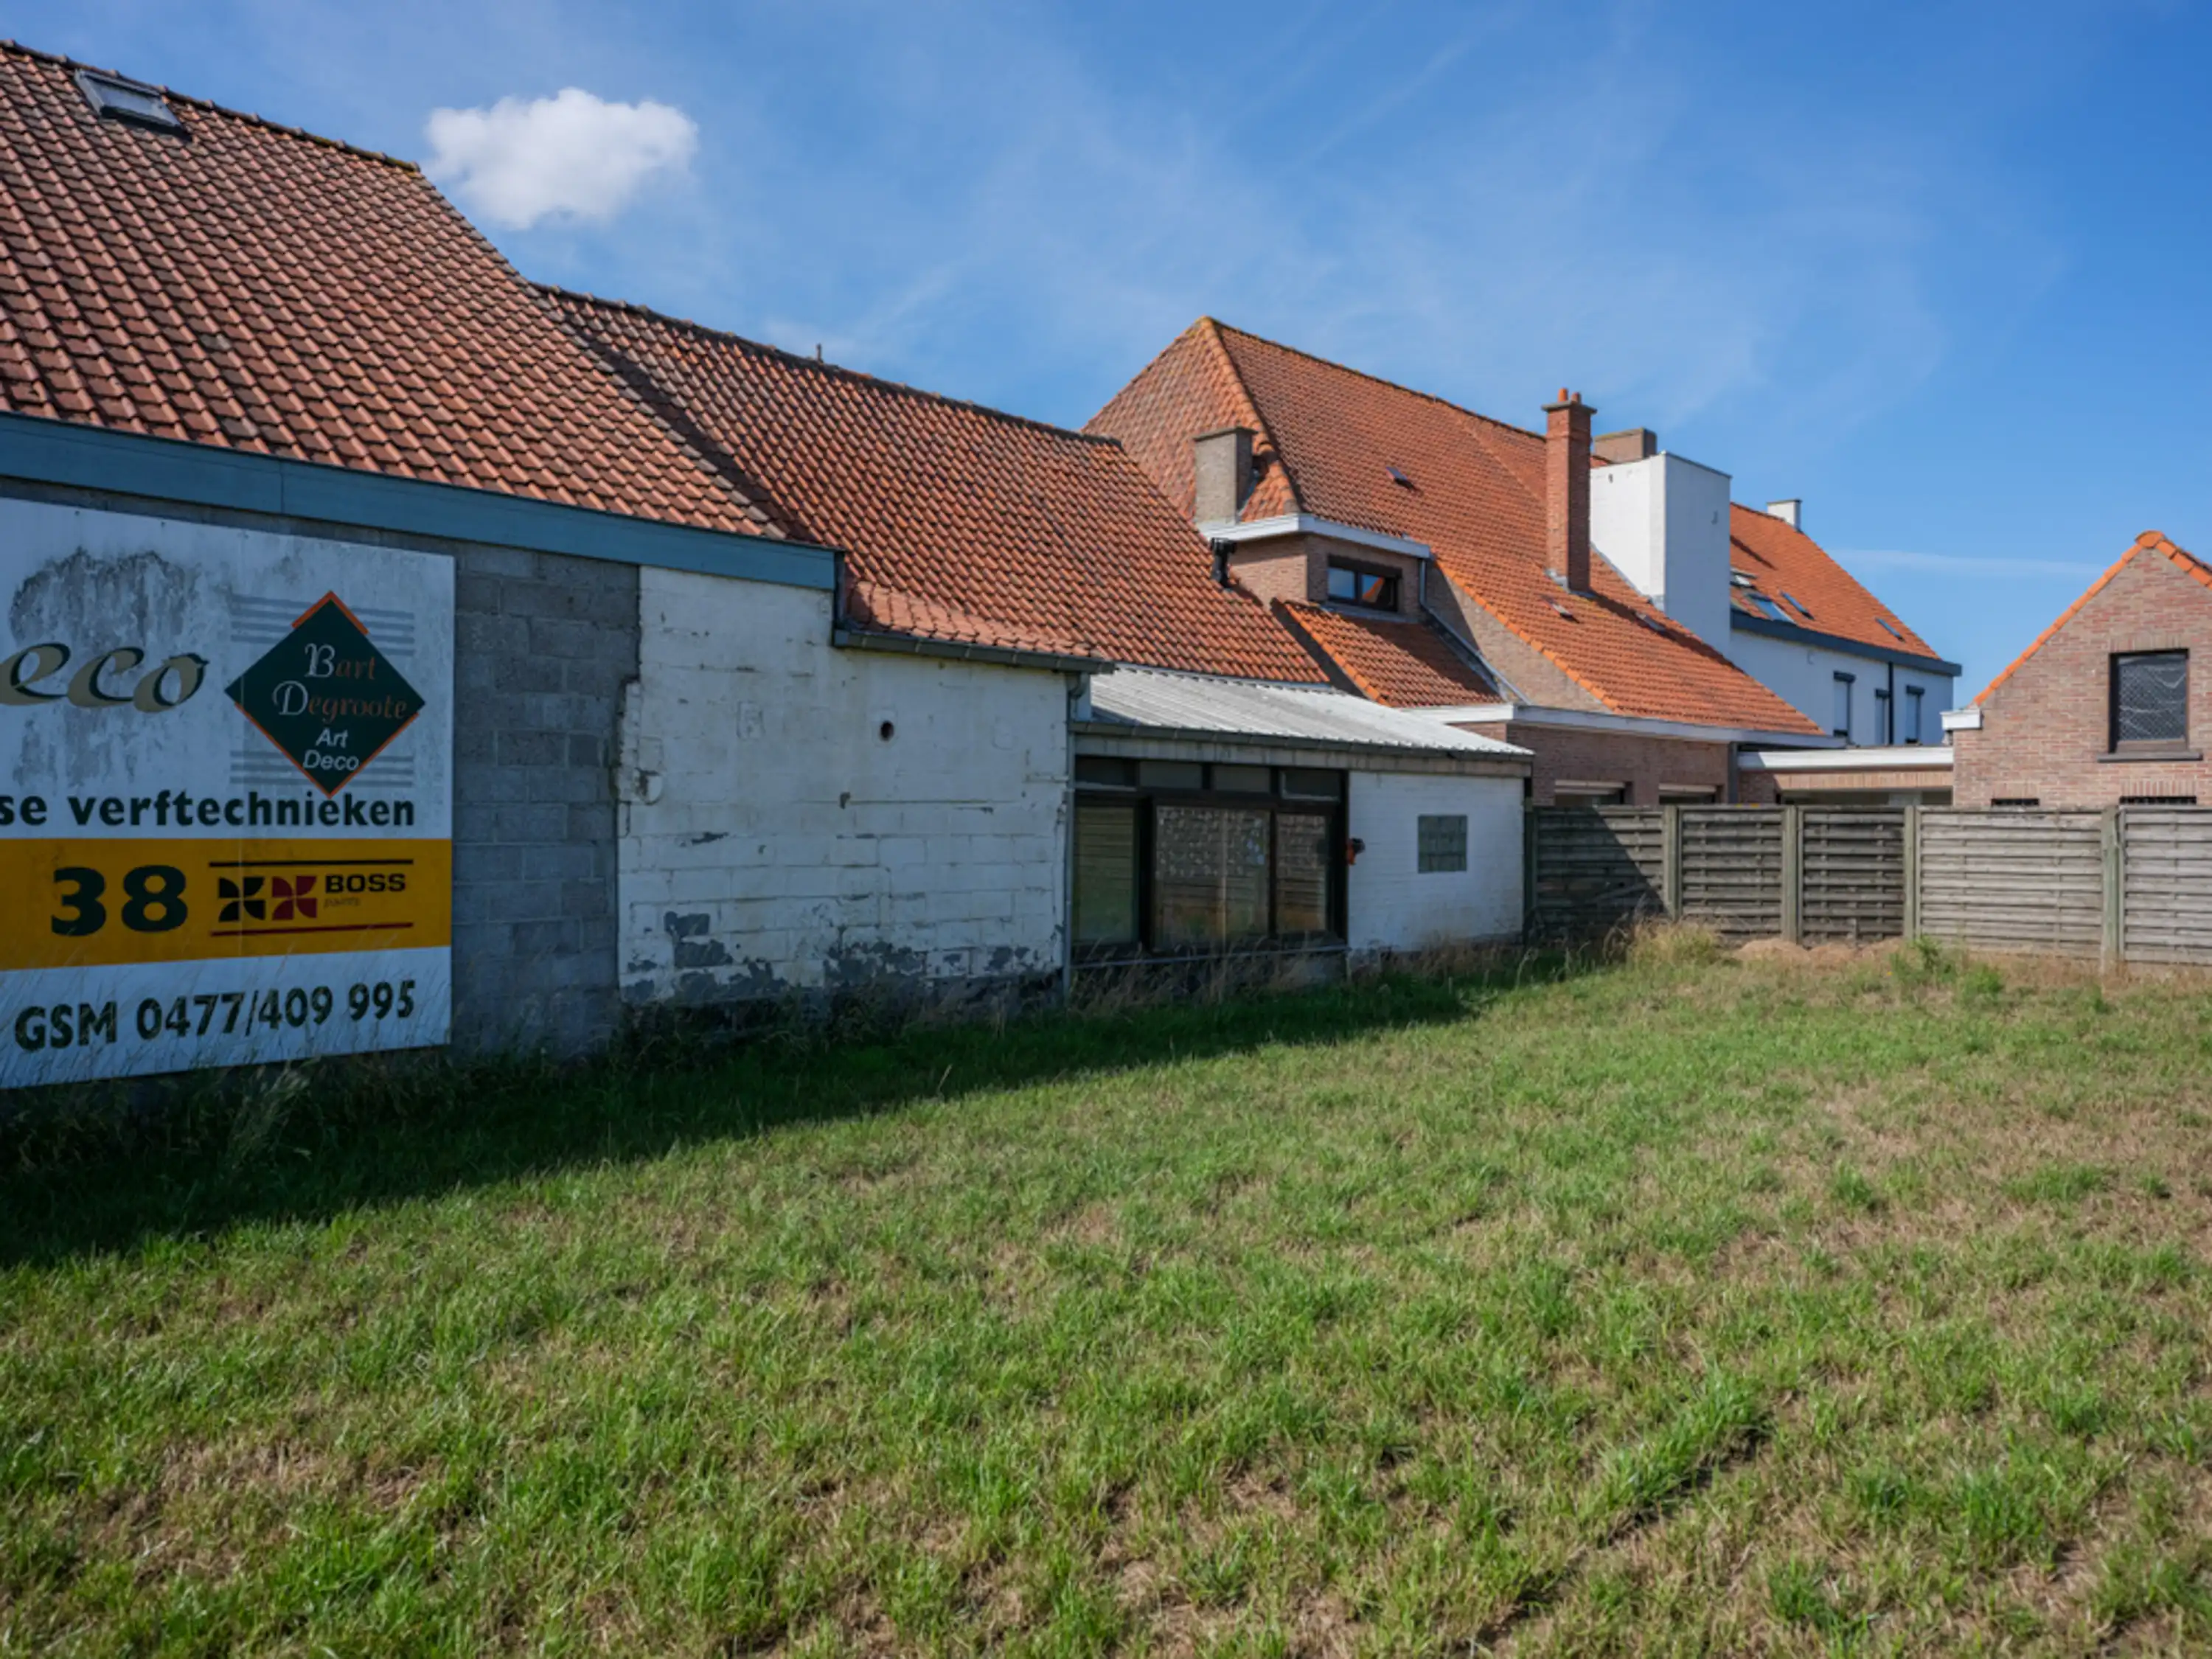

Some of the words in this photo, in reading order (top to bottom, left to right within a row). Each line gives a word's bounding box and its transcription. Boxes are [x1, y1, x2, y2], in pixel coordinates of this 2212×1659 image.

[304, 643, 376, 680] Bart
[272, 681, 407, 723] Degroote
[315, 727, 349, 748] Art
[302, 749, 360, 771] Deco
[68, 790, 415, 827] verftechnieken
[50, 865, 189, 937] 38
[325, 873, 406, 894] BOSS
[14, 1001, 118, 1052] GSM
[136, 985, 334, 1041] 0477/409
[348, 979, 416, 1021] 995
